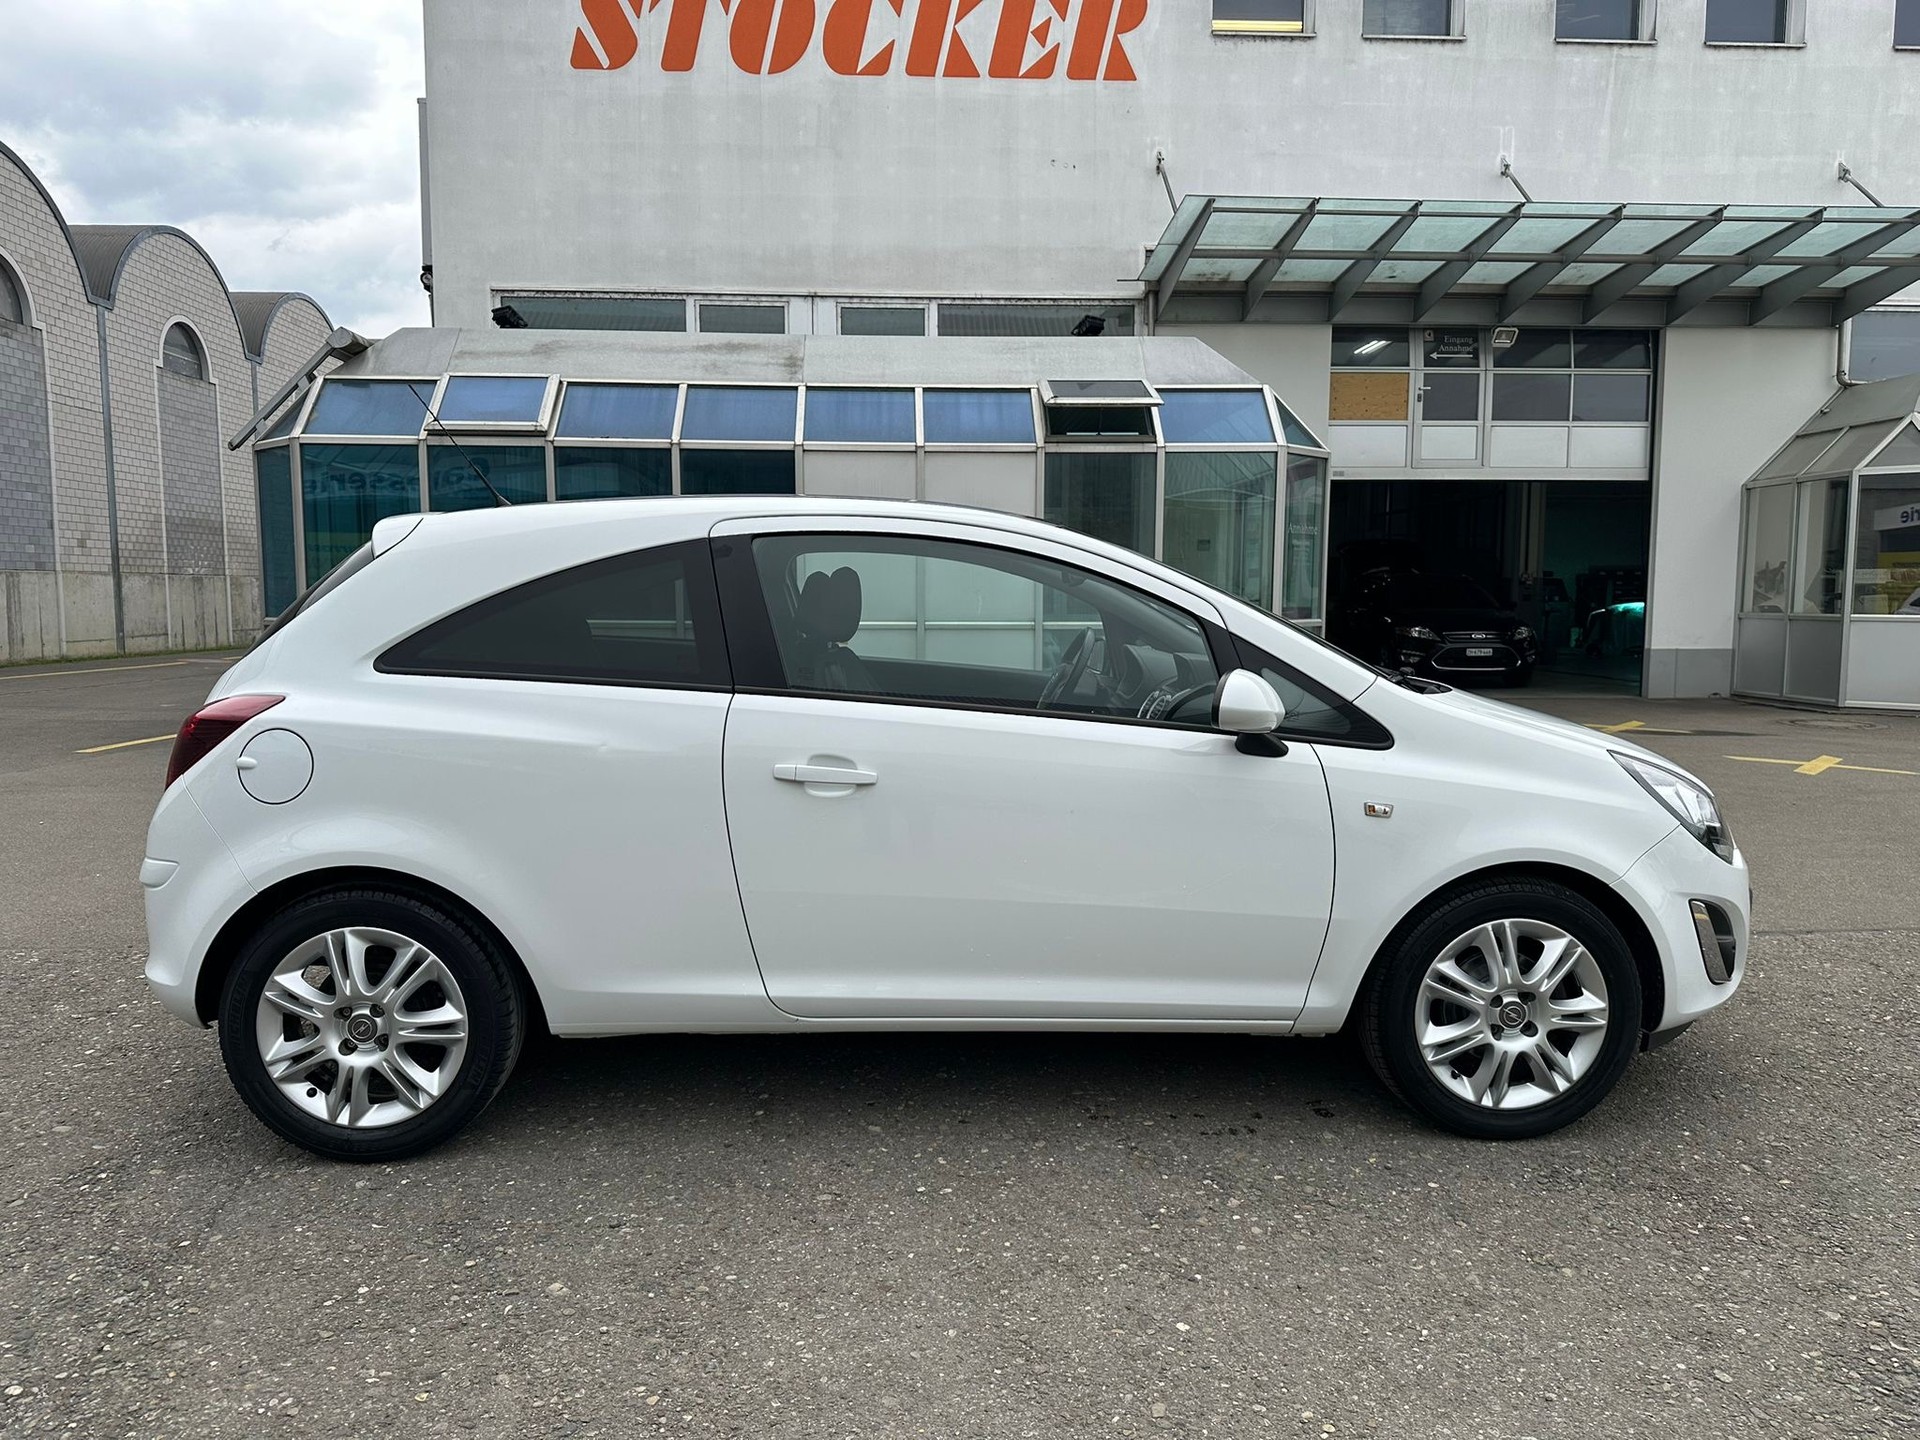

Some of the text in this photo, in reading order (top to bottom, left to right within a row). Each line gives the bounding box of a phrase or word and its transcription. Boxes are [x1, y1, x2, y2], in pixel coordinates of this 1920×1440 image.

[569, 0, 1138, 81] STOCKER
[1443, 335, 1474, 345] Eingang
[1438, 344, 1474, 352] Annahme
